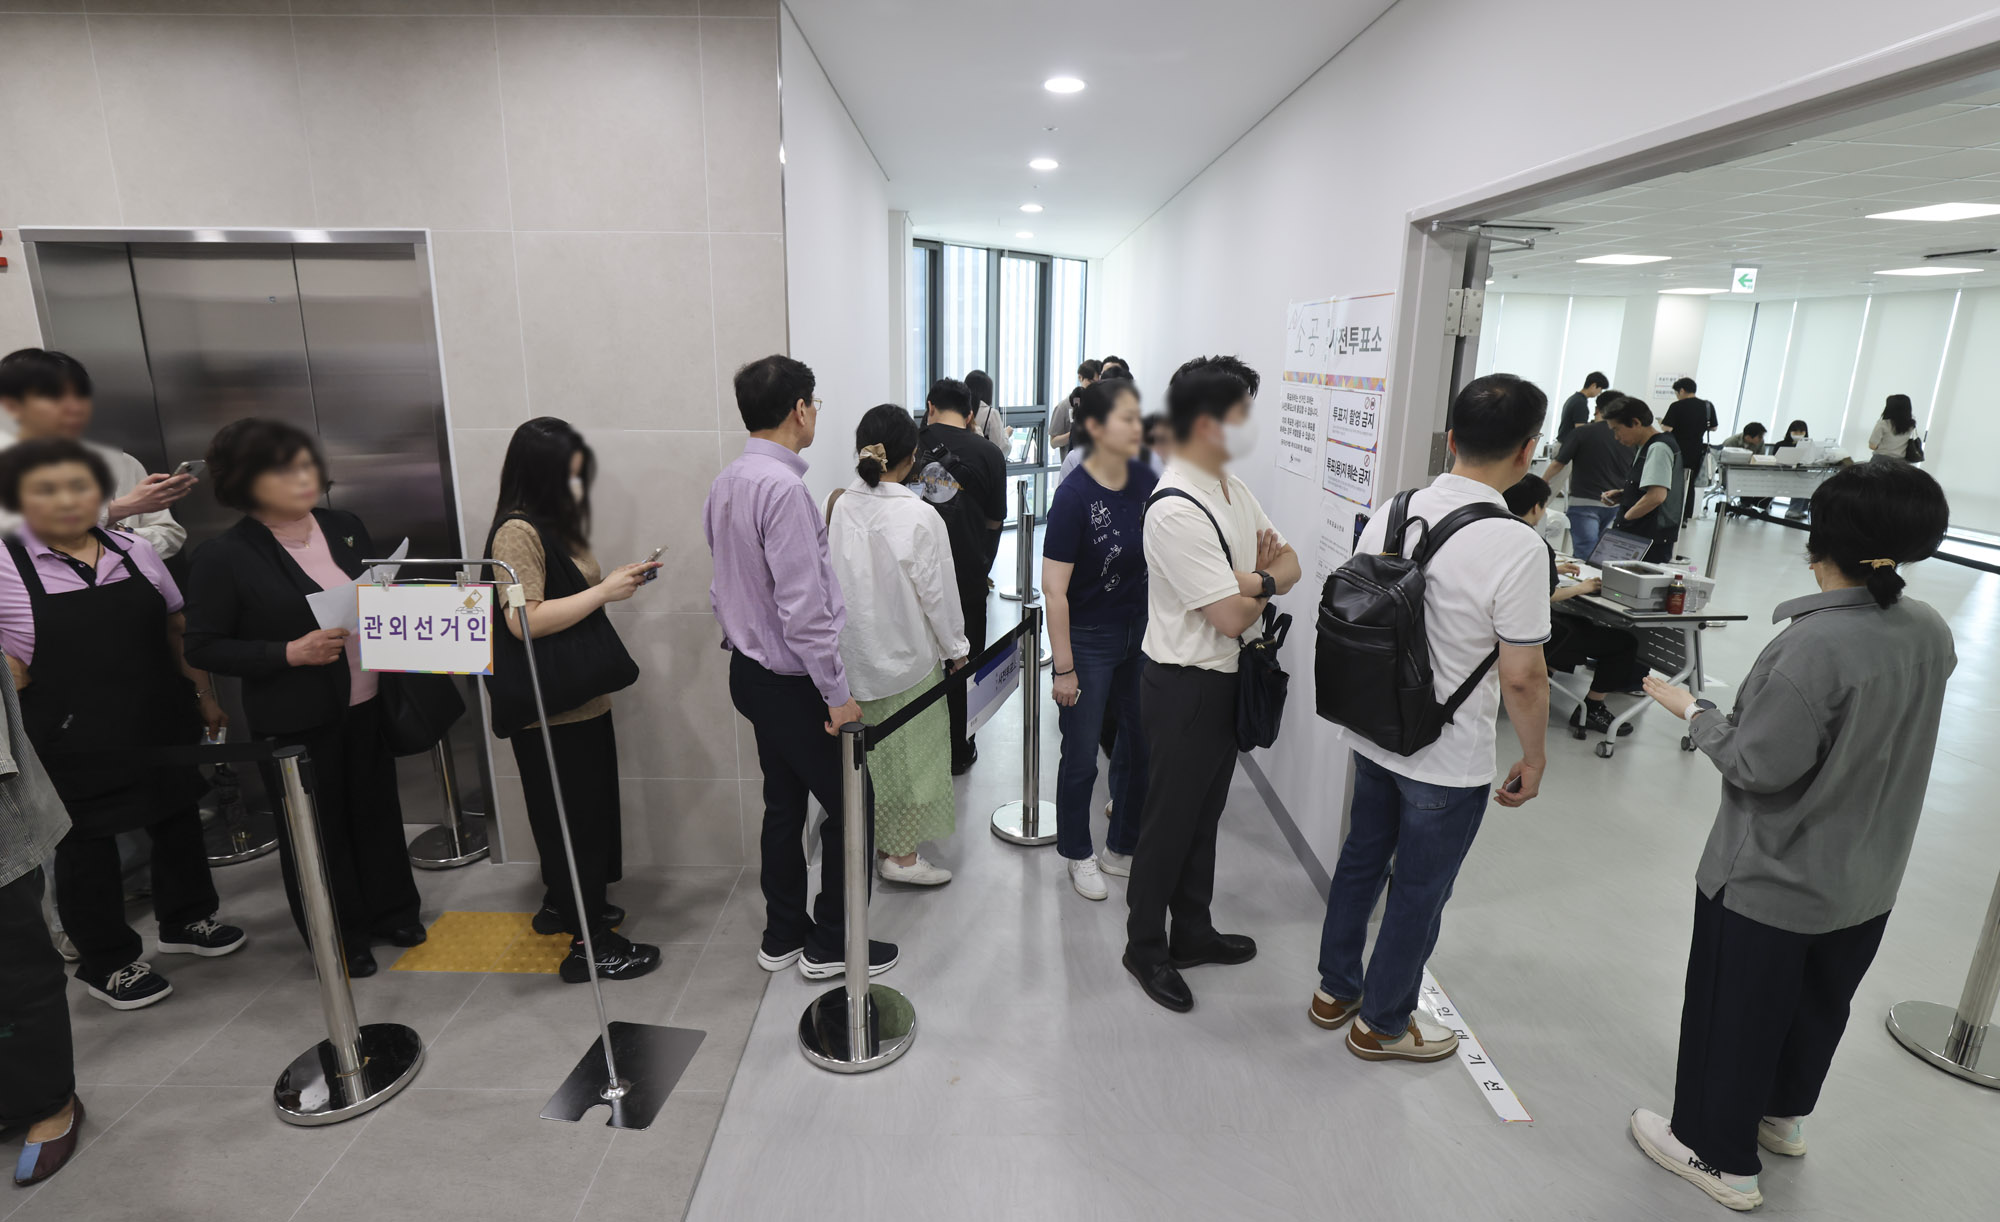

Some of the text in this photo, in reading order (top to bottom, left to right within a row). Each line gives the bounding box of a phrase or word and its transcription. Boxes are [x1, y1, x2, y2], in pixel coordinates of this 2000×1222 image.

[1333, 406, 1375, 430] 투표지 촬영 금지
[1327, 457, 1347, 479] 투표(용)지
[1347, 463, 1358, 482] 훼손
[1358, 467, 1371, 487] 금지
[363, 615, 487, 642] 관외선거인
[1688, 1157, 1721, 1180] HOKA
